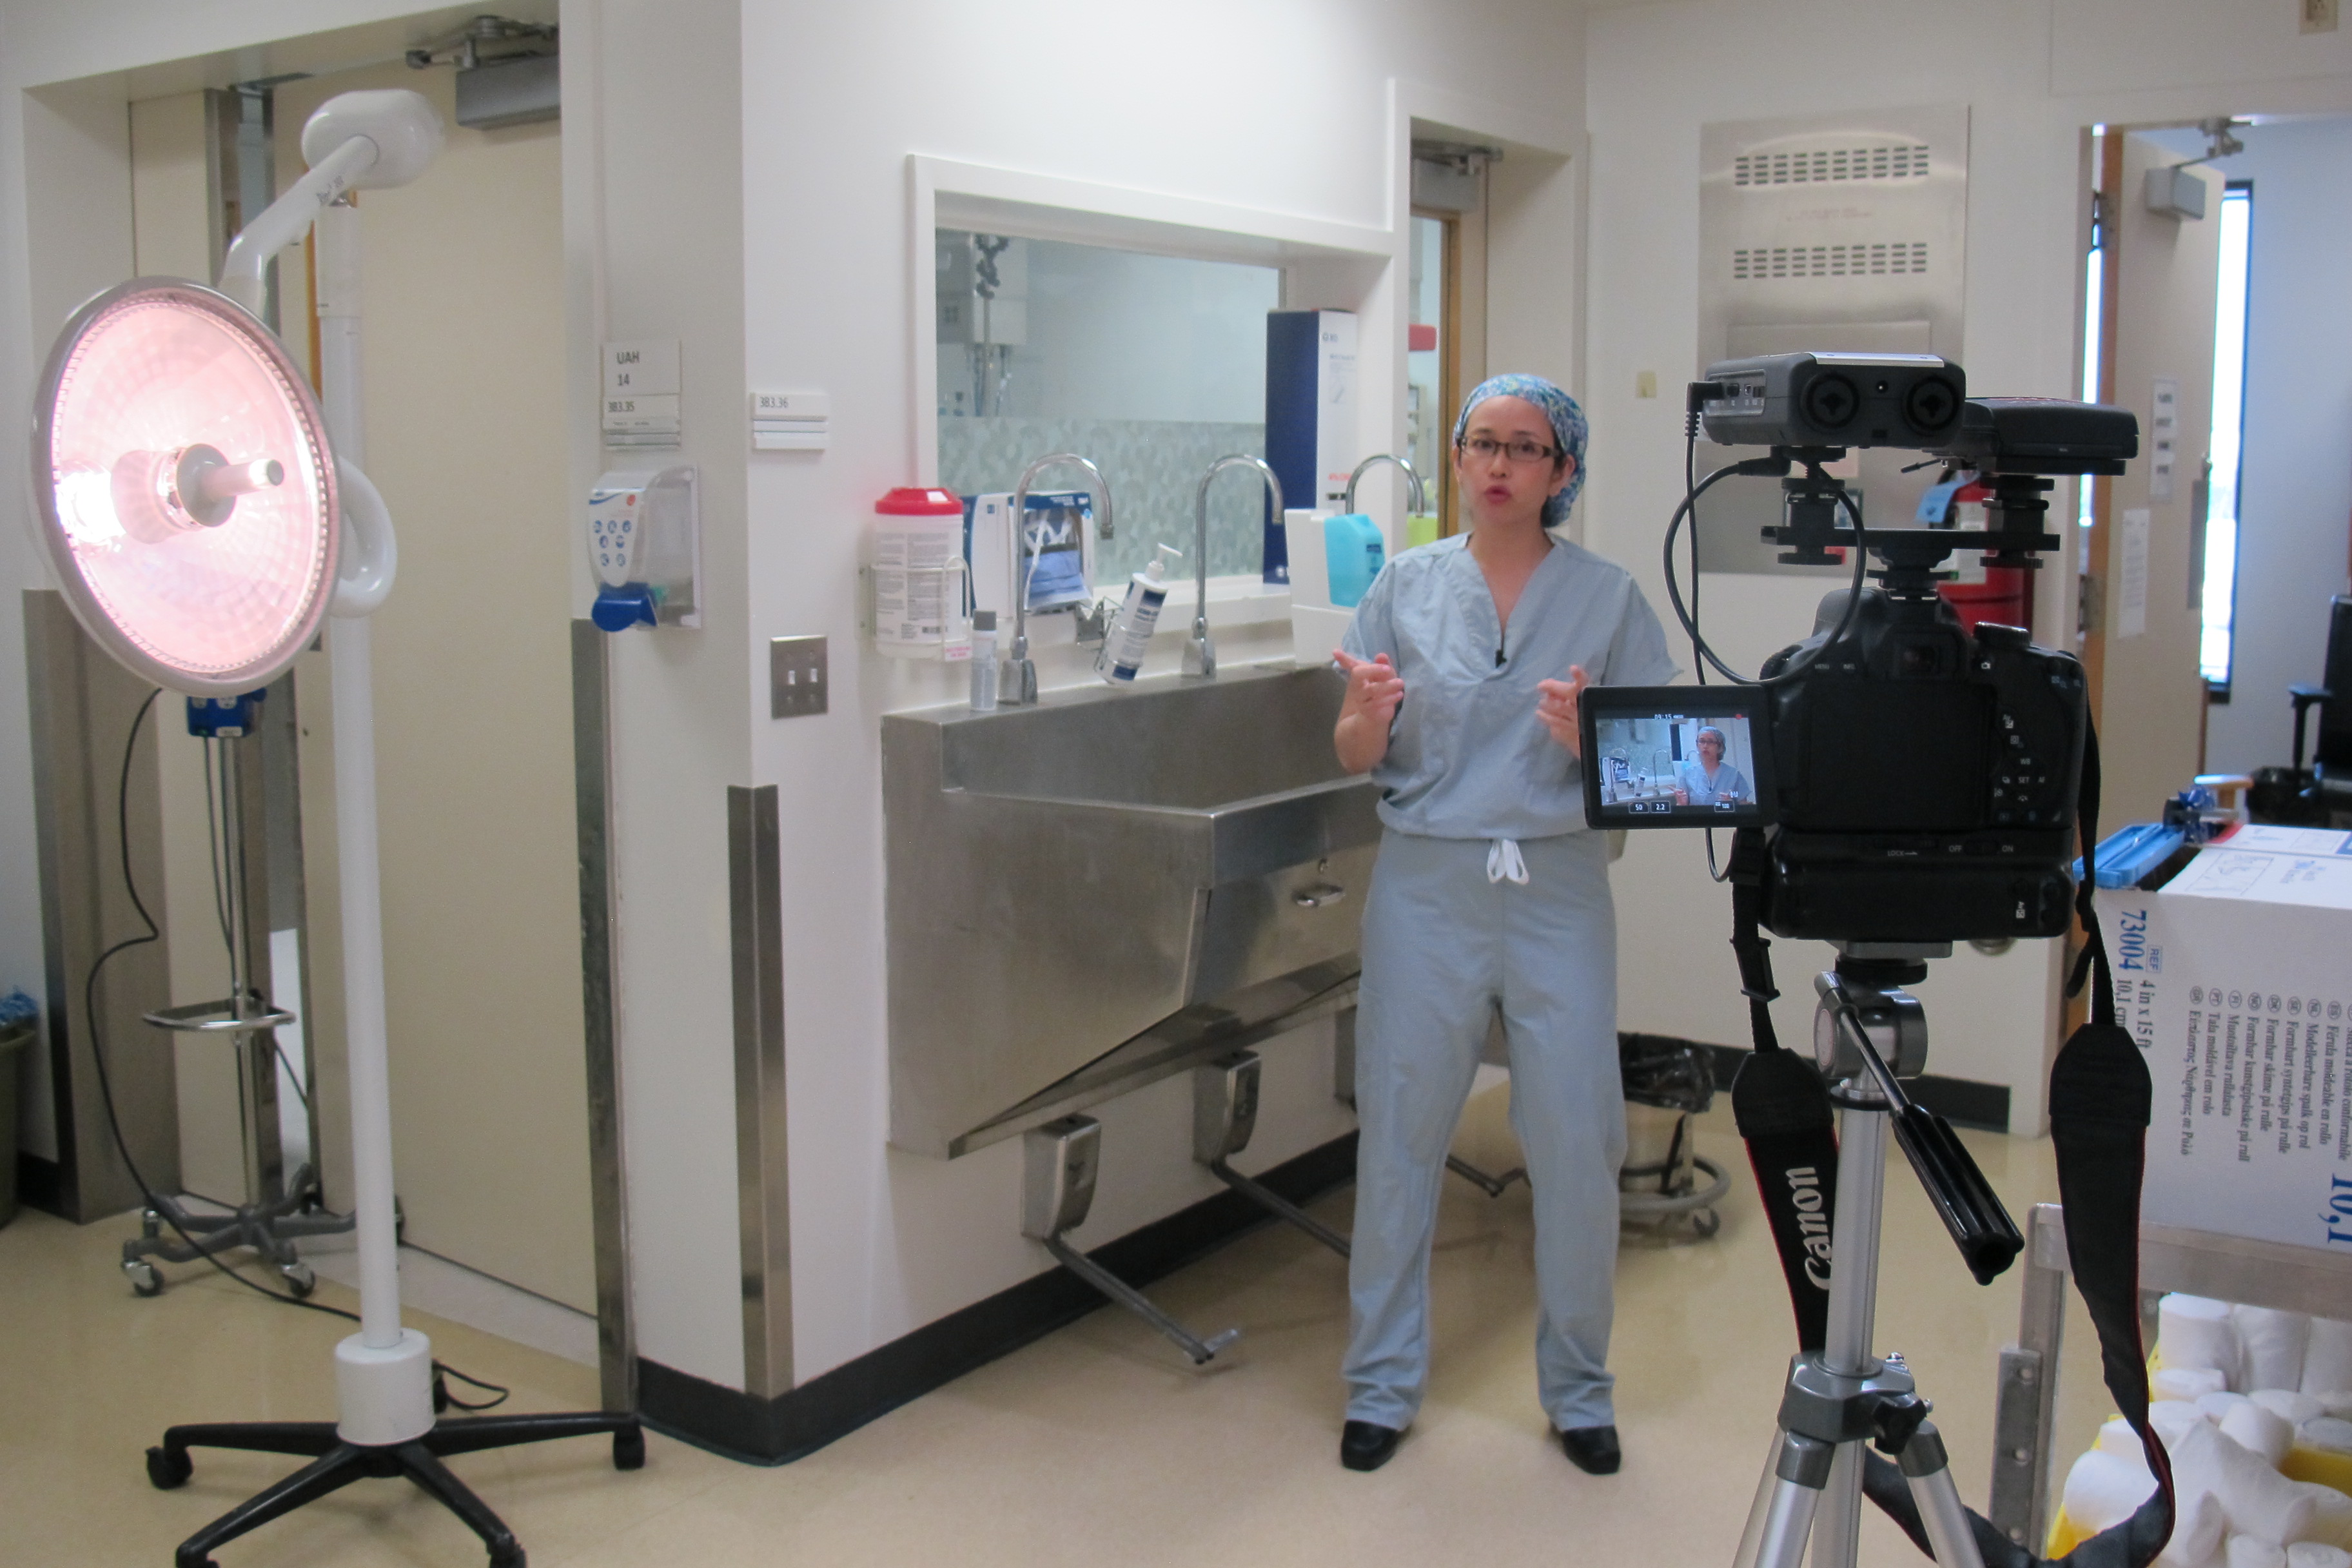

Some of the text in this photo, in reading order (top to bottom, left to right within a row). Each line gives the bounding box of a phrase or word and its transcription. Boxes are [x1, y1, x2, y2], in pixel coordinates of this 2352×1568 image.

[616, 350, 640, 364] UAH
[617, 373, 630, 386] 14
[1948, 845, 1963, 853] OFF
[2001, 845, 2014, 853] ON
[2118, 910, 2147, 970] 73004
[2149, 947, 2160, 971] REF
[2115, 979, 2132, 1003] 10,1
[2136, 979, 2155, 1049] 4 in x 15 ft
[2208, 1012, 2220, 1033] Tala
[2245, 1016, 2260, 1059] Formbar
[2264, 1019, 2280, 1061] Formbar
[2284, 1021, 2300, 1066] Formbart
[2325, 1026, 2340, 1056] Férula
[2204, 1035, 2219, 1078] moldável
[2302, 1023, 2320, 1092] Modelleerbare
[2204, 1079, 2213, 1093] em
[2262, 1063, 2276, 1093] skinne
[2322, 1059, 2336, 1107] moldeable
[2202, 1096, 2215, 1115] rolo
[2298, 1093, 2313, 1118] spalk
[2321, 1109, 2329, 1120] en
[2260, 1110, 2273, 1132] rulle
[2297, 1120, 2309, 1133] op
[2338, 1098, 2352, 1161] conformabile
[2278, 1132, 2291, 1153] rulle
[2298, 1135, 2311, 1149] rol
[2320, 1122, 2333, 1145] rollo
[2238, 1144, 2251, 1162] rull
[1785, 1166, 1832, 1290] Canon
